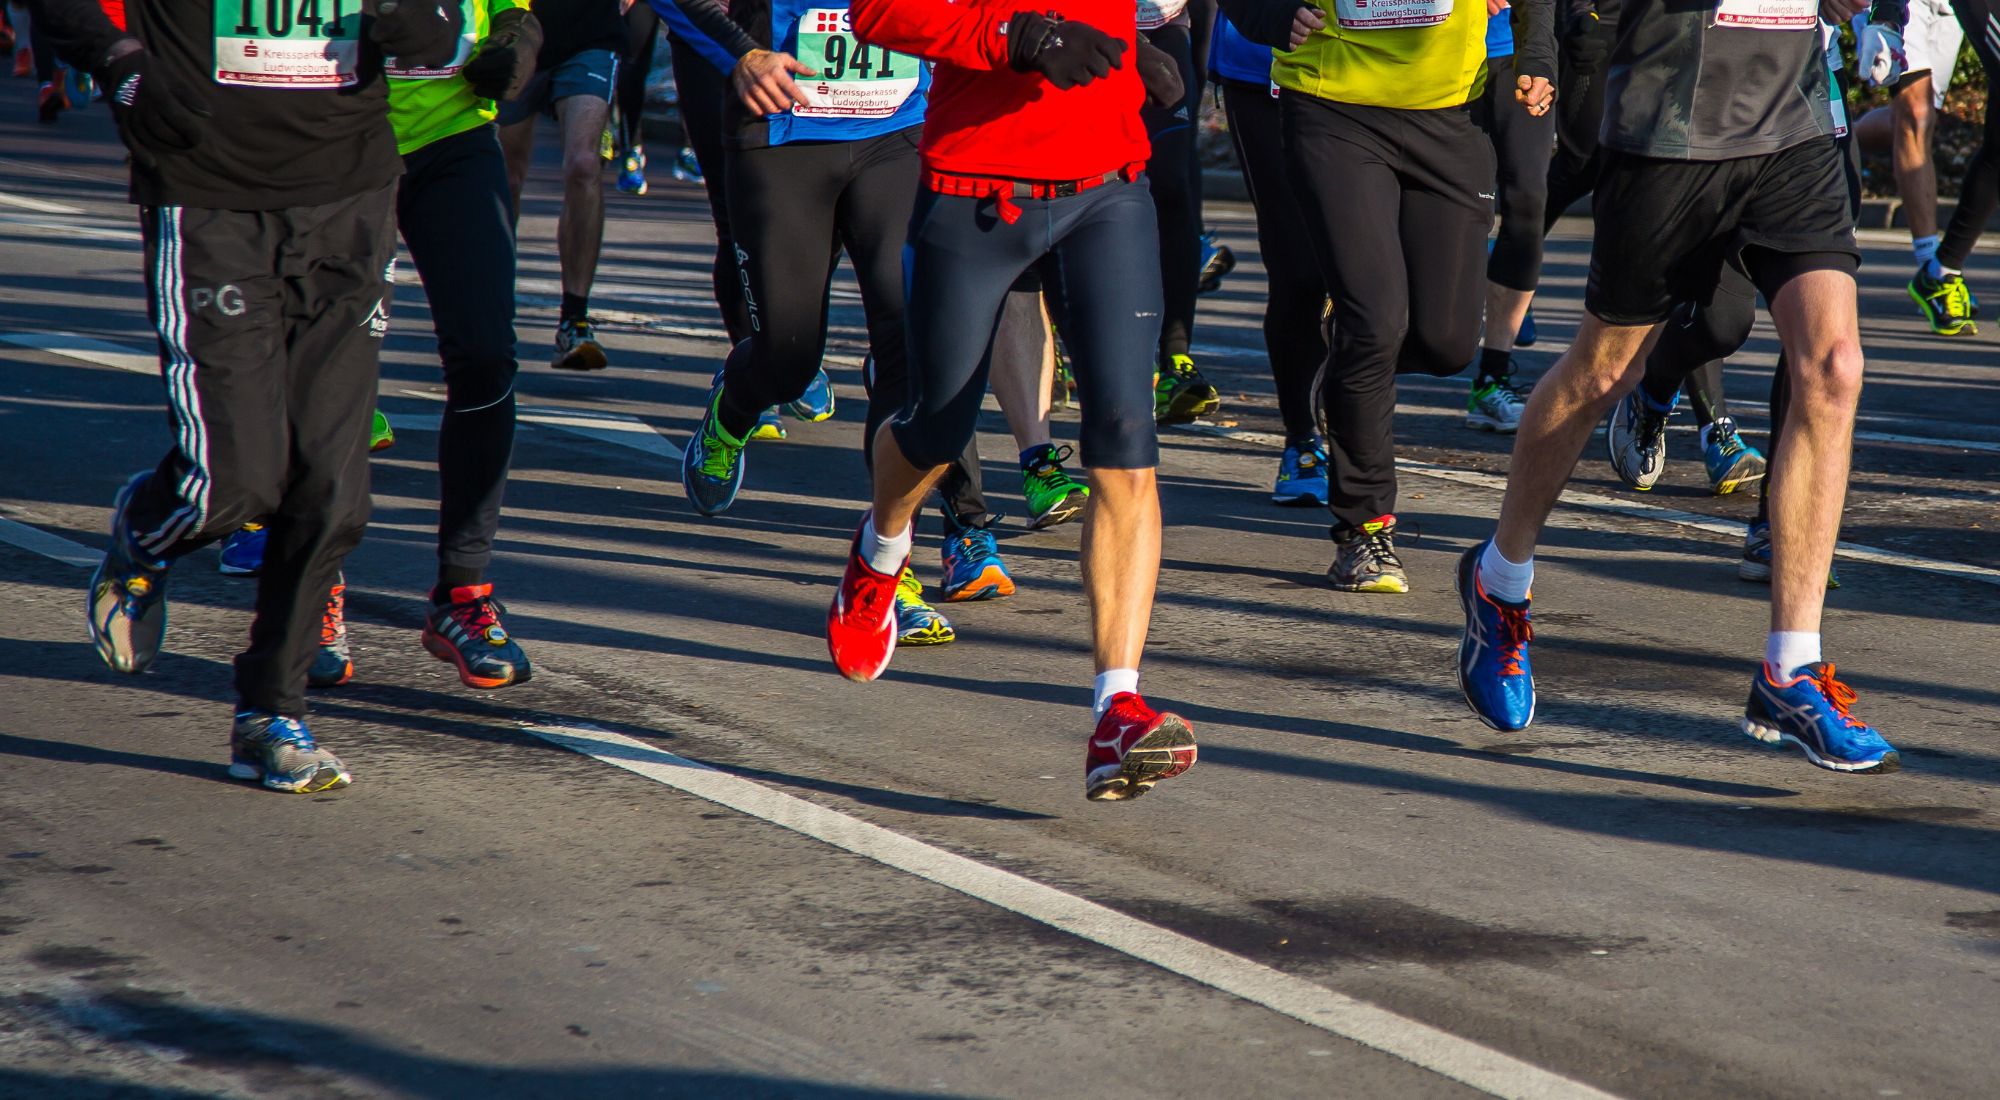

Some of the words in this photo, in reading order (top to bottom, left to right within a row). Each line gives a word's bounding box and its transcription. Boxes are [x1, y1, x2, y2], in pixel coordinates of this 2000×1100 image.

[1371, 8, 1427, 18] Ludwigsburg
[1758, 5, 1805, 17] Ludwigsburg
[235, 0, 347, 37] 1041
[1353, 19, 1394, 27] Bietigheimer
[1737, 16, 1777, 24] Bietigheimer
[1778, 17, 1809, 25] Silvesterlauf
[824, 35, 894, 79] 941
[264, 62, 329, 74] Ludwigsburg
[833, 88, 898, 97] Kreissparkasse
[832, 98, 889, 108] Ludwigsburg
[191, 284, 246, 316] PG
